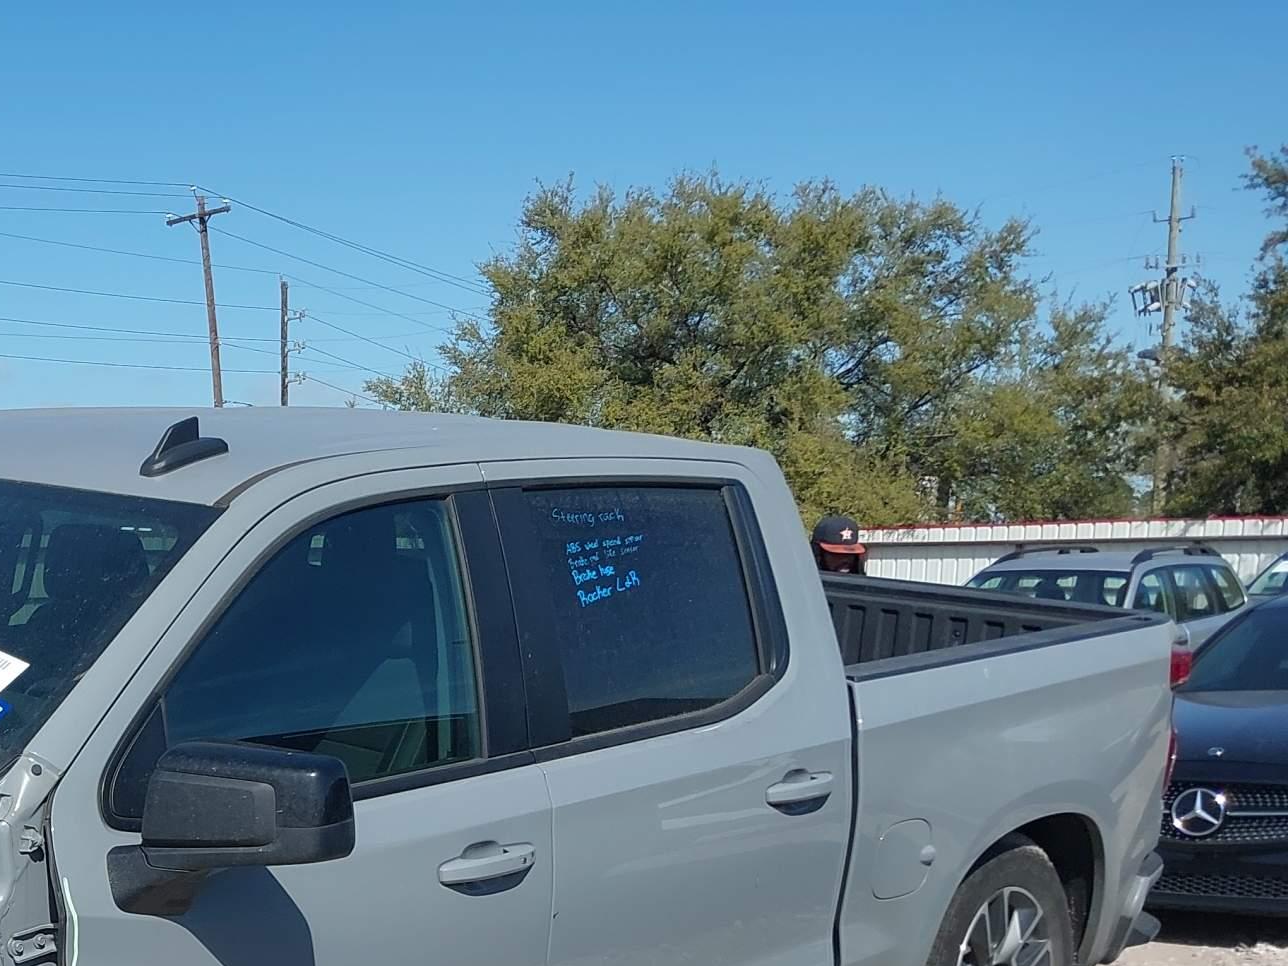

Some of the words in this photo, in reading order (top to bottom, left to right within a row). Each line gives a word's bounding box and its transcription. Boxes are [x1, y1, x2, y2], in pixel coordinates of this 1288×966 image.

[551, 507, 595, 527] Steering
[598, 508, 625, 522] rack
[566, 541, 582, 555] ABS
[571, 569, 598, 586] Brake
[598, 564, 616, 577] hose
[577, 585, 613, 608] Rocker
